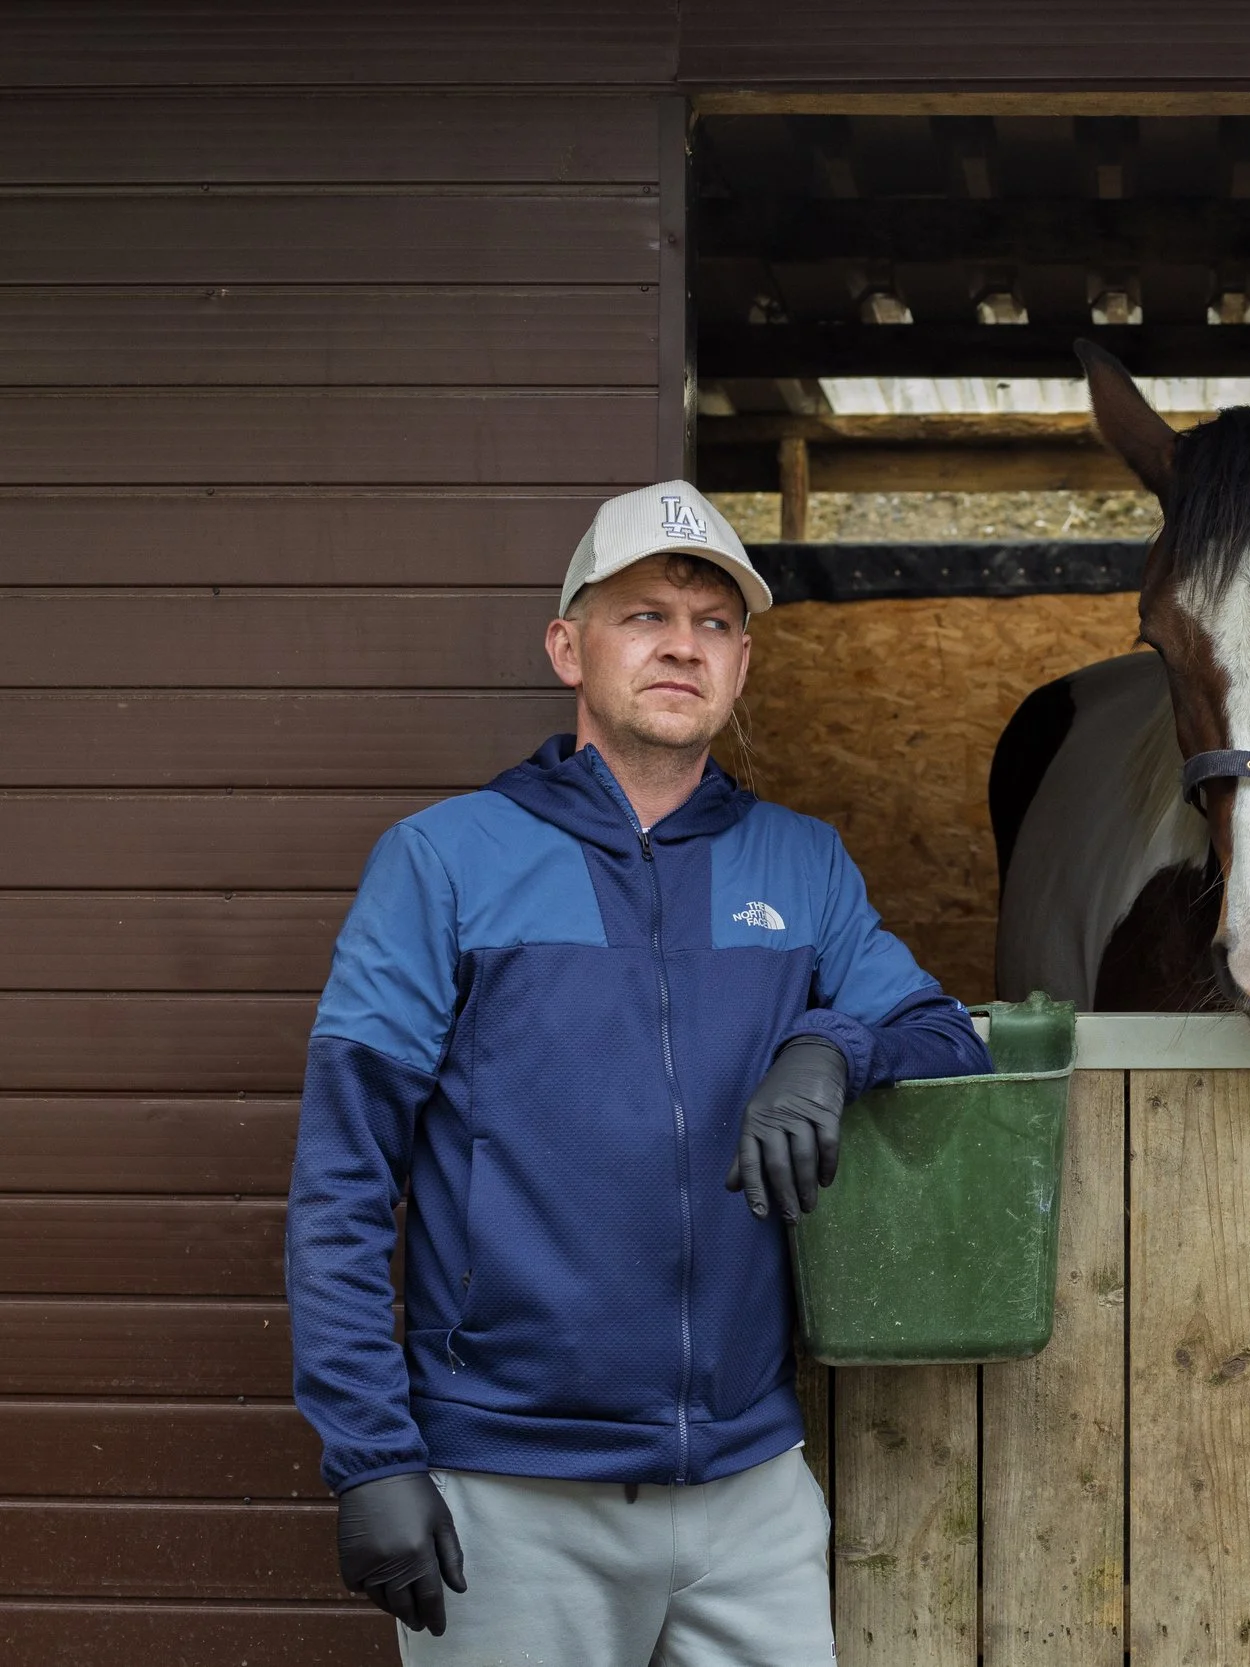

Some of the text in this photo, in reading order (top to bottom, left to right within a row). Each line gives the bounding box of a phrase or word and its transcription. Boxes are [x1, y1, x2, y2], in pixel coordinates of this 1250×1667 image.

[661, 496, 707, 543] LA
[746, 901, 765, 910] THE
[732, 909, 766, 922] NORTH
[746, 917, 768, 929] FACE
